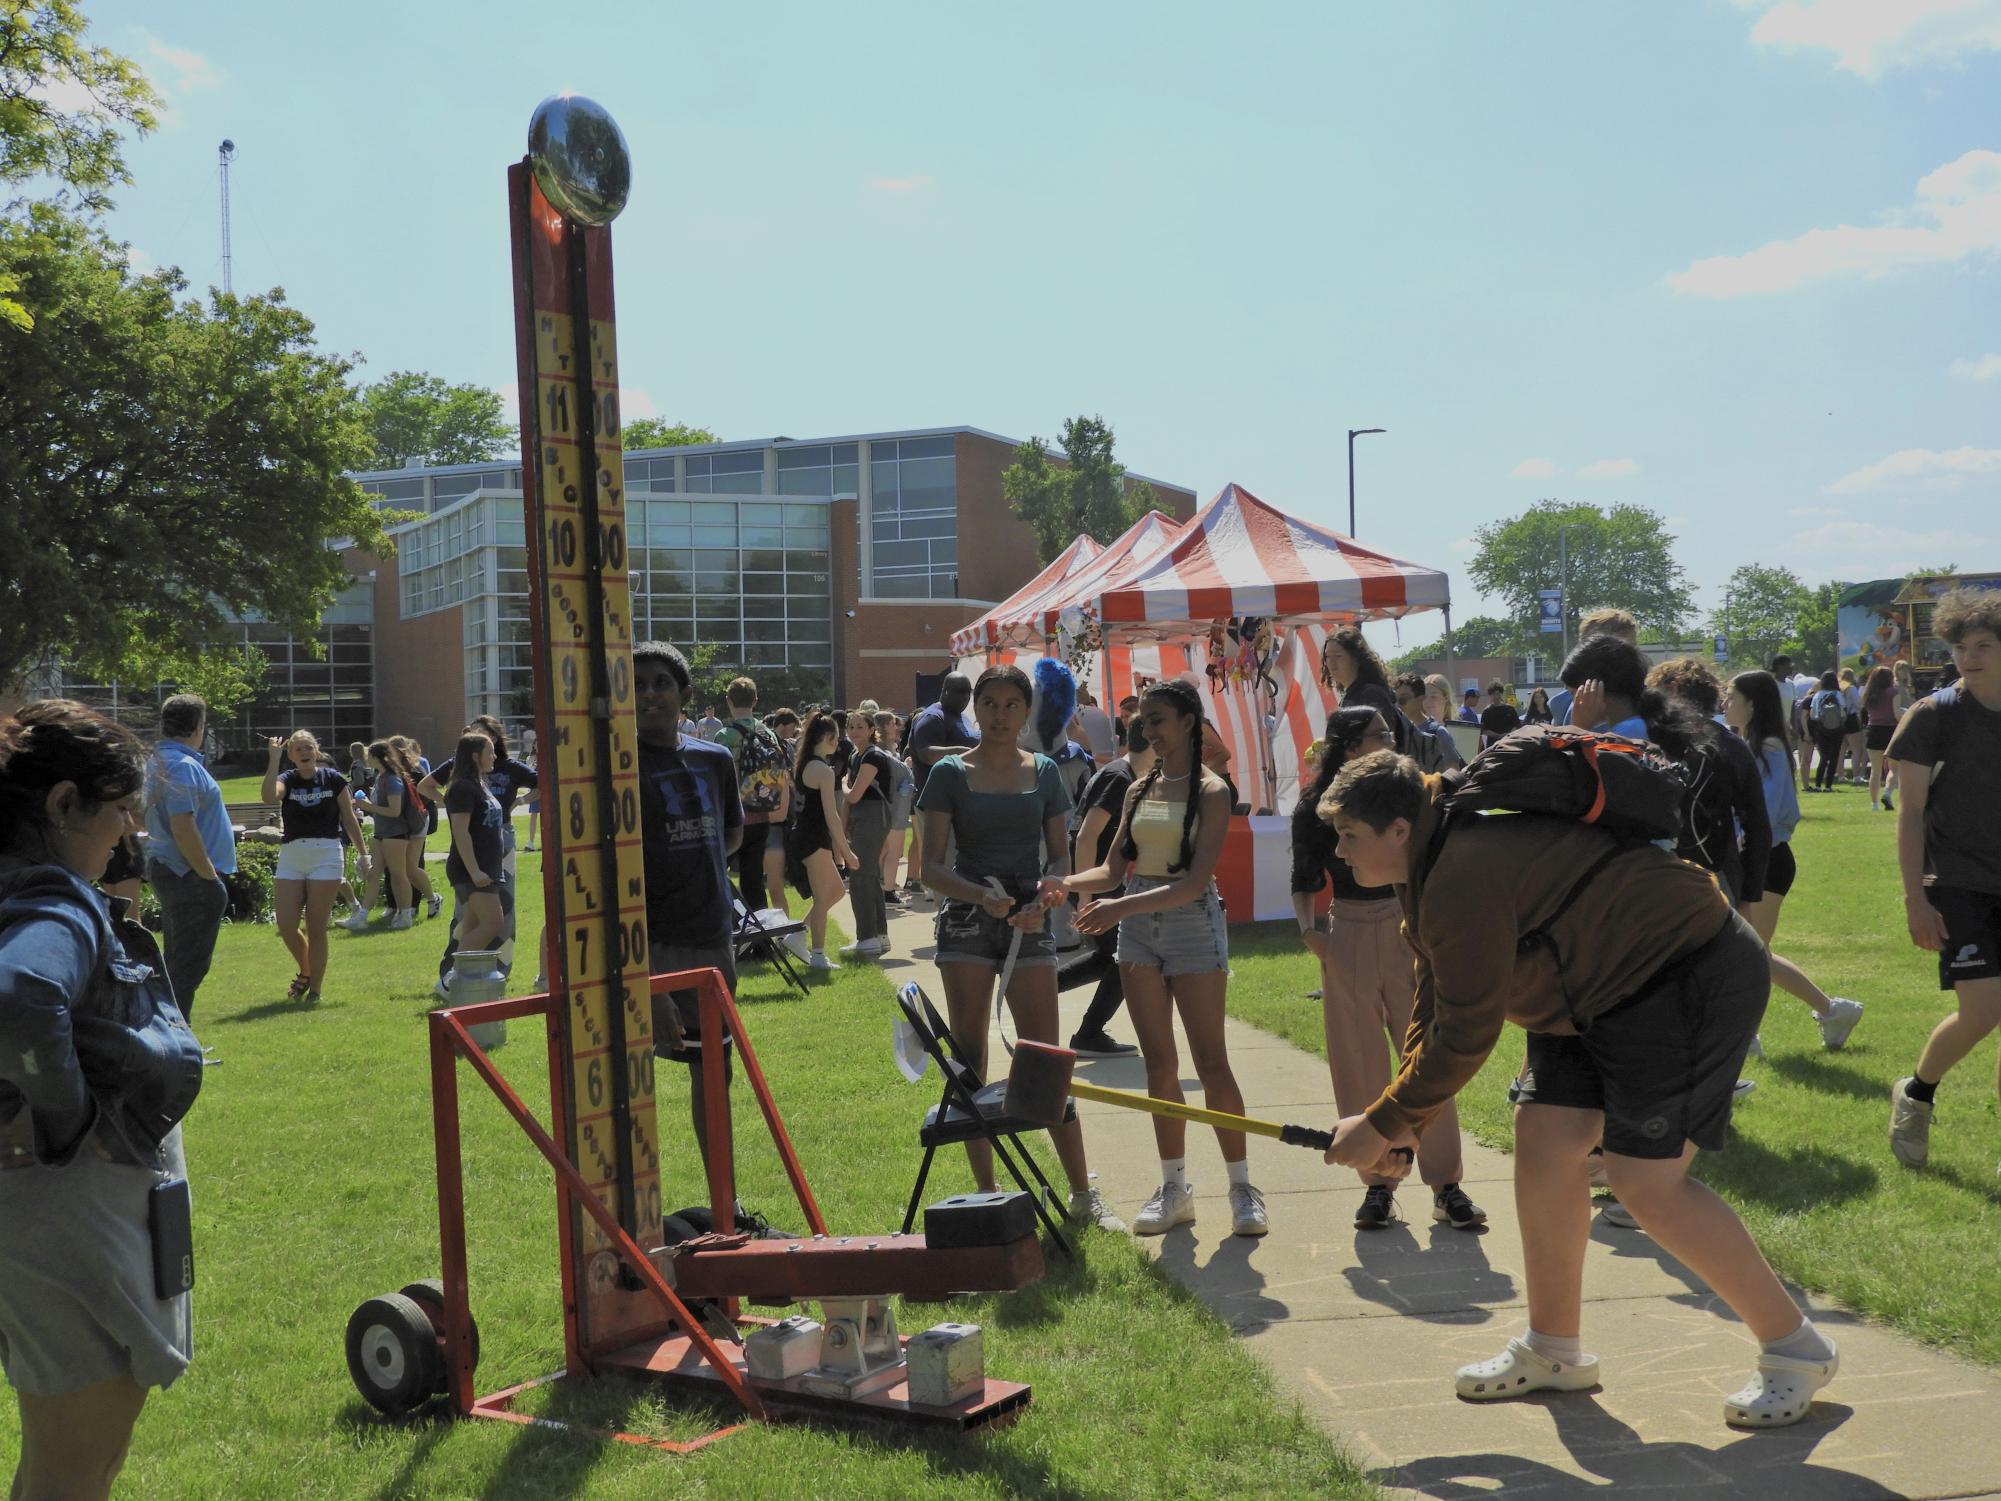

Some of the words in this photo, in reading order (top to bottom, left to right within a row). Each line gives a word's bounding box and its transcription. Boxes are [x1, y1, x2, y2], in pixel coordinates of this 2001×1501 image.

[541, 316, 569, 371] HIT
[546, 383, 569, 433] 11
[544, 447, 578, 503] BIG
[548, 518, 577, 568] 10
[551, 584, 584, 638] GOOD
[561, 655, 578, 704] 9
[549, 725, 585, 768] HI
[570, 791, 585, 840] 8
[566, 857, 597, 910] ALL
[575, 926, 589, 976] 7
[575, 991, 601, 1047] SICK
[587, 1058, 603, 1108] 6
[627, 1047, 654, 1099] 00
[583, 1123, 613, 1180] DEAD
